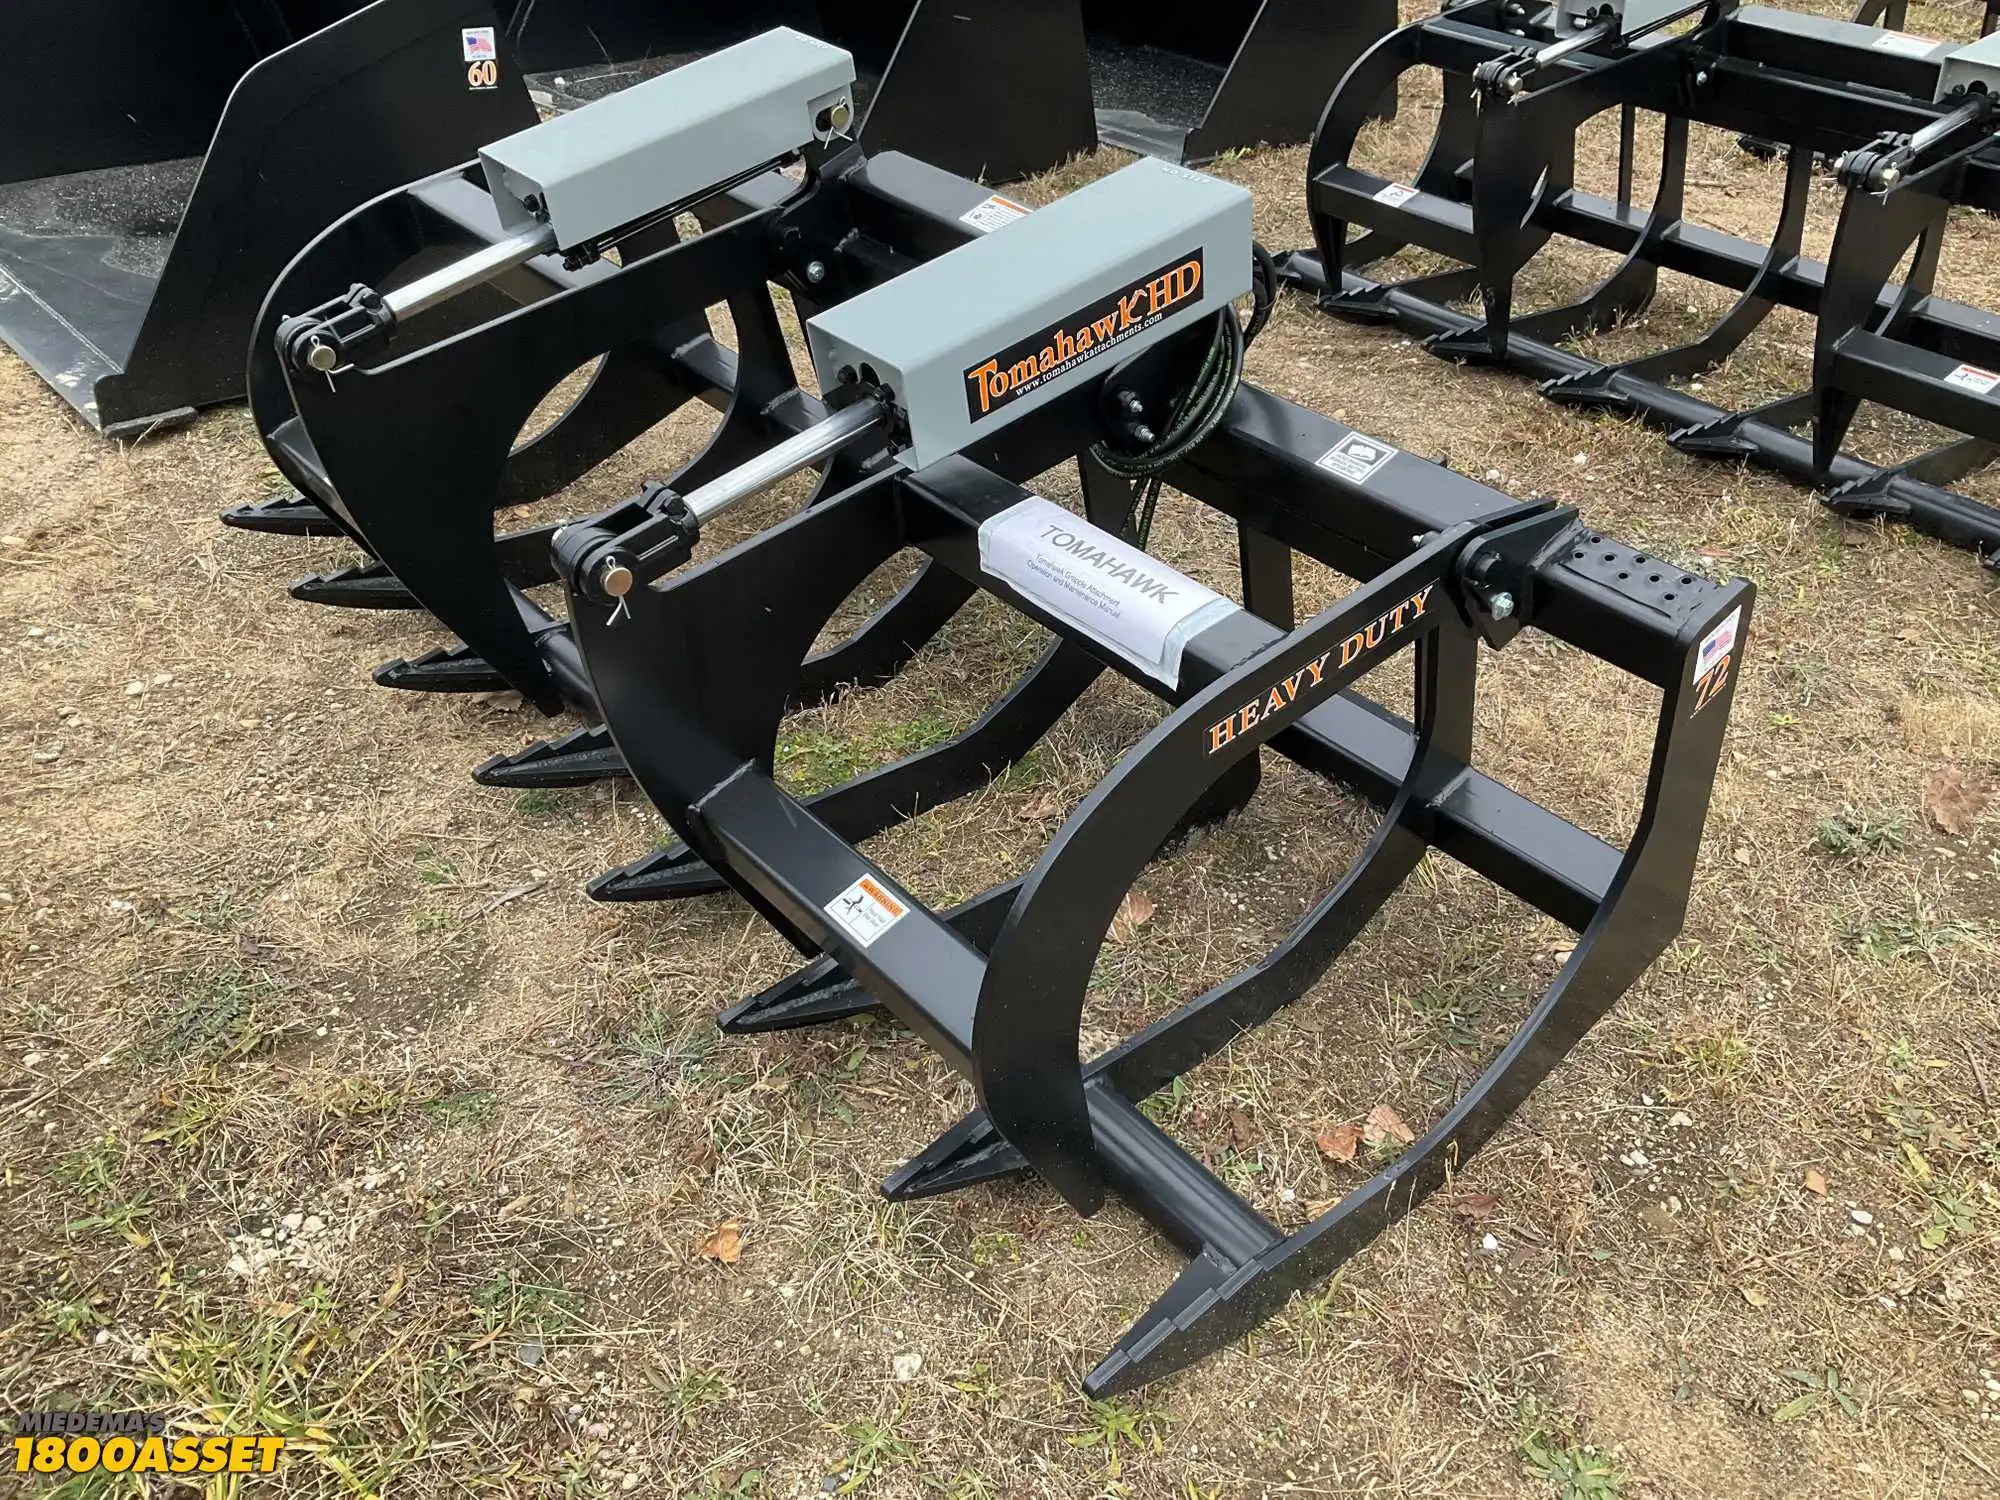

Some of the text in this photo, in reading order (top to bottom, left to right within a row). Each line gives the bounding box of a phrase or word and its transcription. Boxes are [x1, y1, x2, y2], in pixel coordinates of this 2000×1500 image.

[467, 60, 497, 87] 60
[1145, 259, 1202, 316] HD
[1015, 311, 1163, 398] www.tomahawkattachments.com
[1027, 559, 1053, 579] Operation
[1053, 575, 1065, 586] and
[1040, 524, 1180, 605] TOMAHAWK
[1087, 584, 1121, 607] Attachment
[1208, 584, 1434, 755] HEAVY DUTY
[1694, 654, 1731, 711] 72
